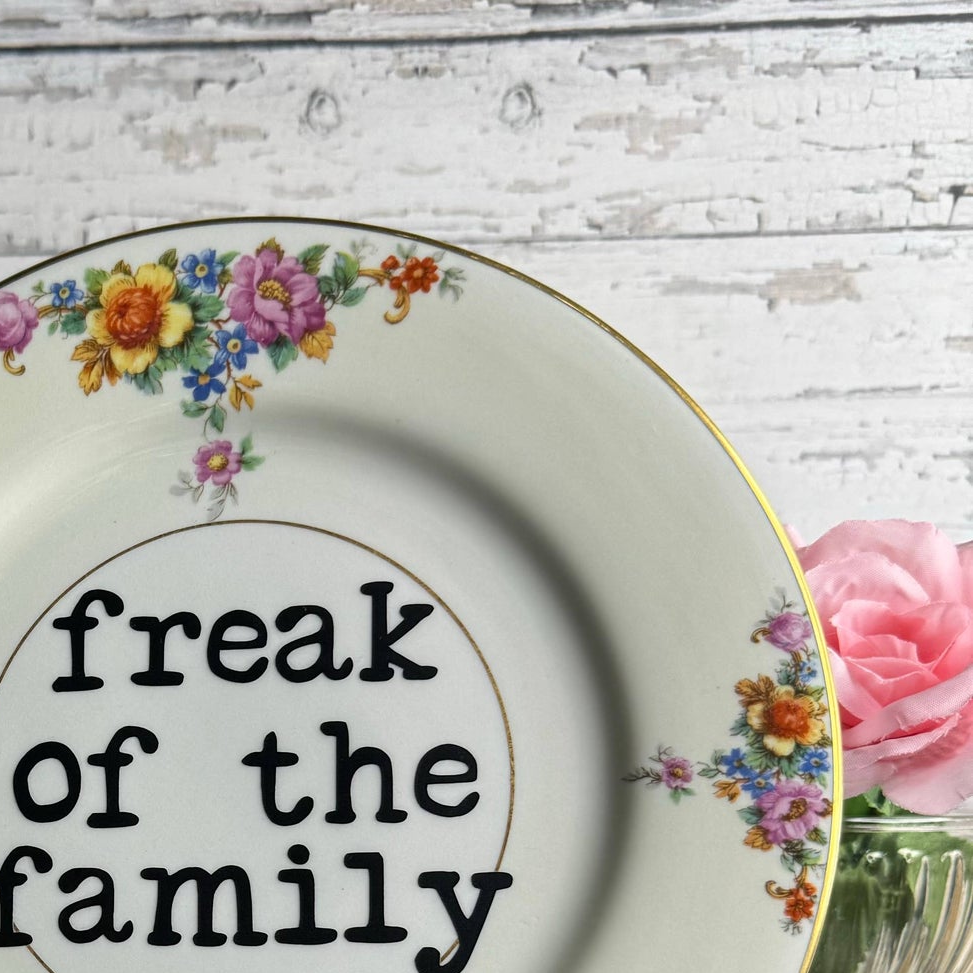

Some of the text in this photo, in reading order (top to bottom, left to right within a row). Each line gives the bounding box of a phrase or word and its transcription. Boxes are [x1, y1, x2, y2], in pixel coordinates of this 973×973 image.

[51, 581, 438, 692] freak
[13, 721, 480, 828] of the
